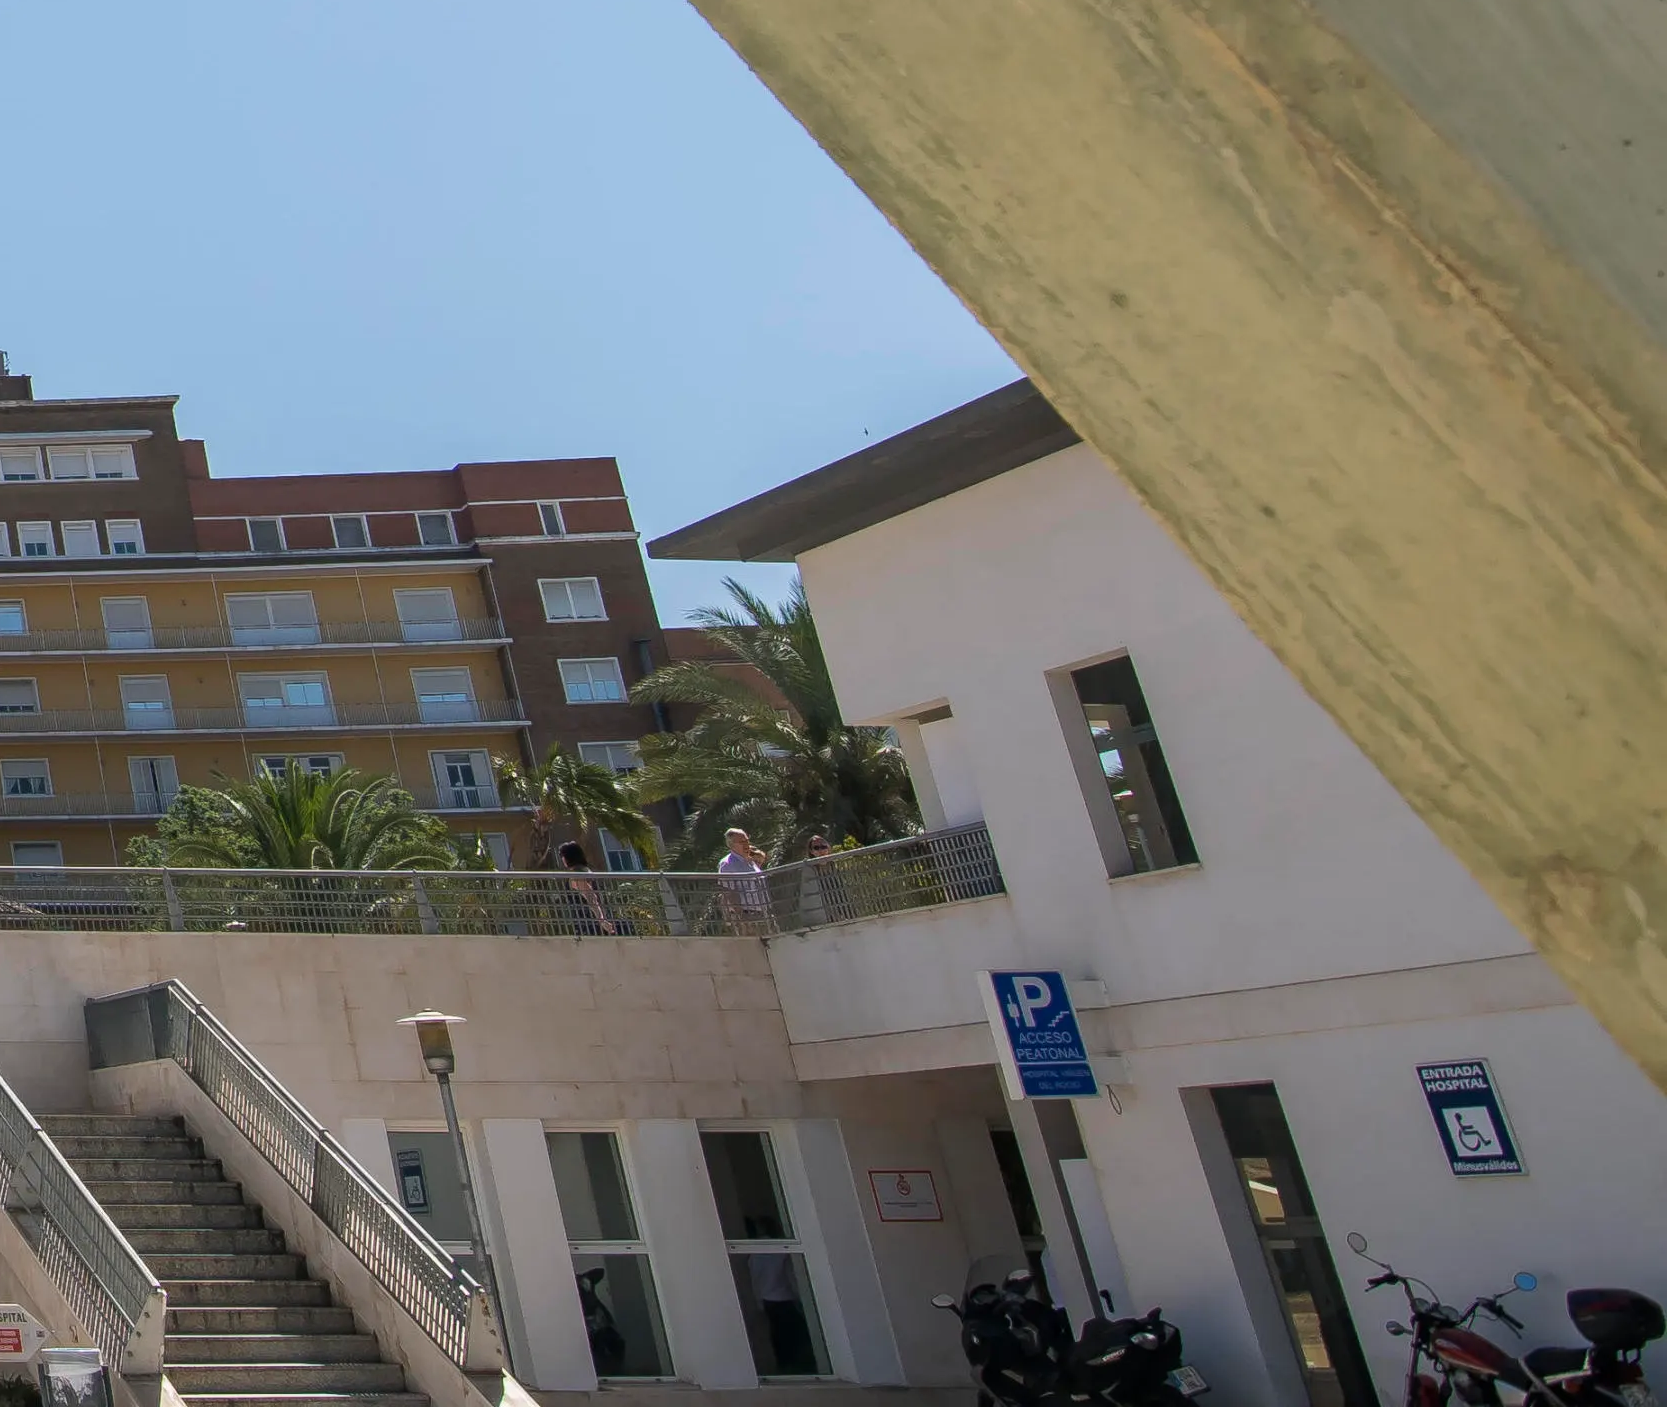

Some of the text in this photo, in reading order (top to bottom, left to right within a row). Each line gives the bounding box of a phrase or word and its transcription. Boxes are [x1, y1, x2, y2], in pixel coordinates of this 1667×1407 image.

[1012, 976, 1052, 1027] P
[1019, 1031, 1072, 1044] ACCESO
[1016, 1047, 1084, 1060] PEATONAL
[1421, 1064, 1484, 1080] ENTRADA
[1425, 1077, 1488, 1092] HOSPITAL
